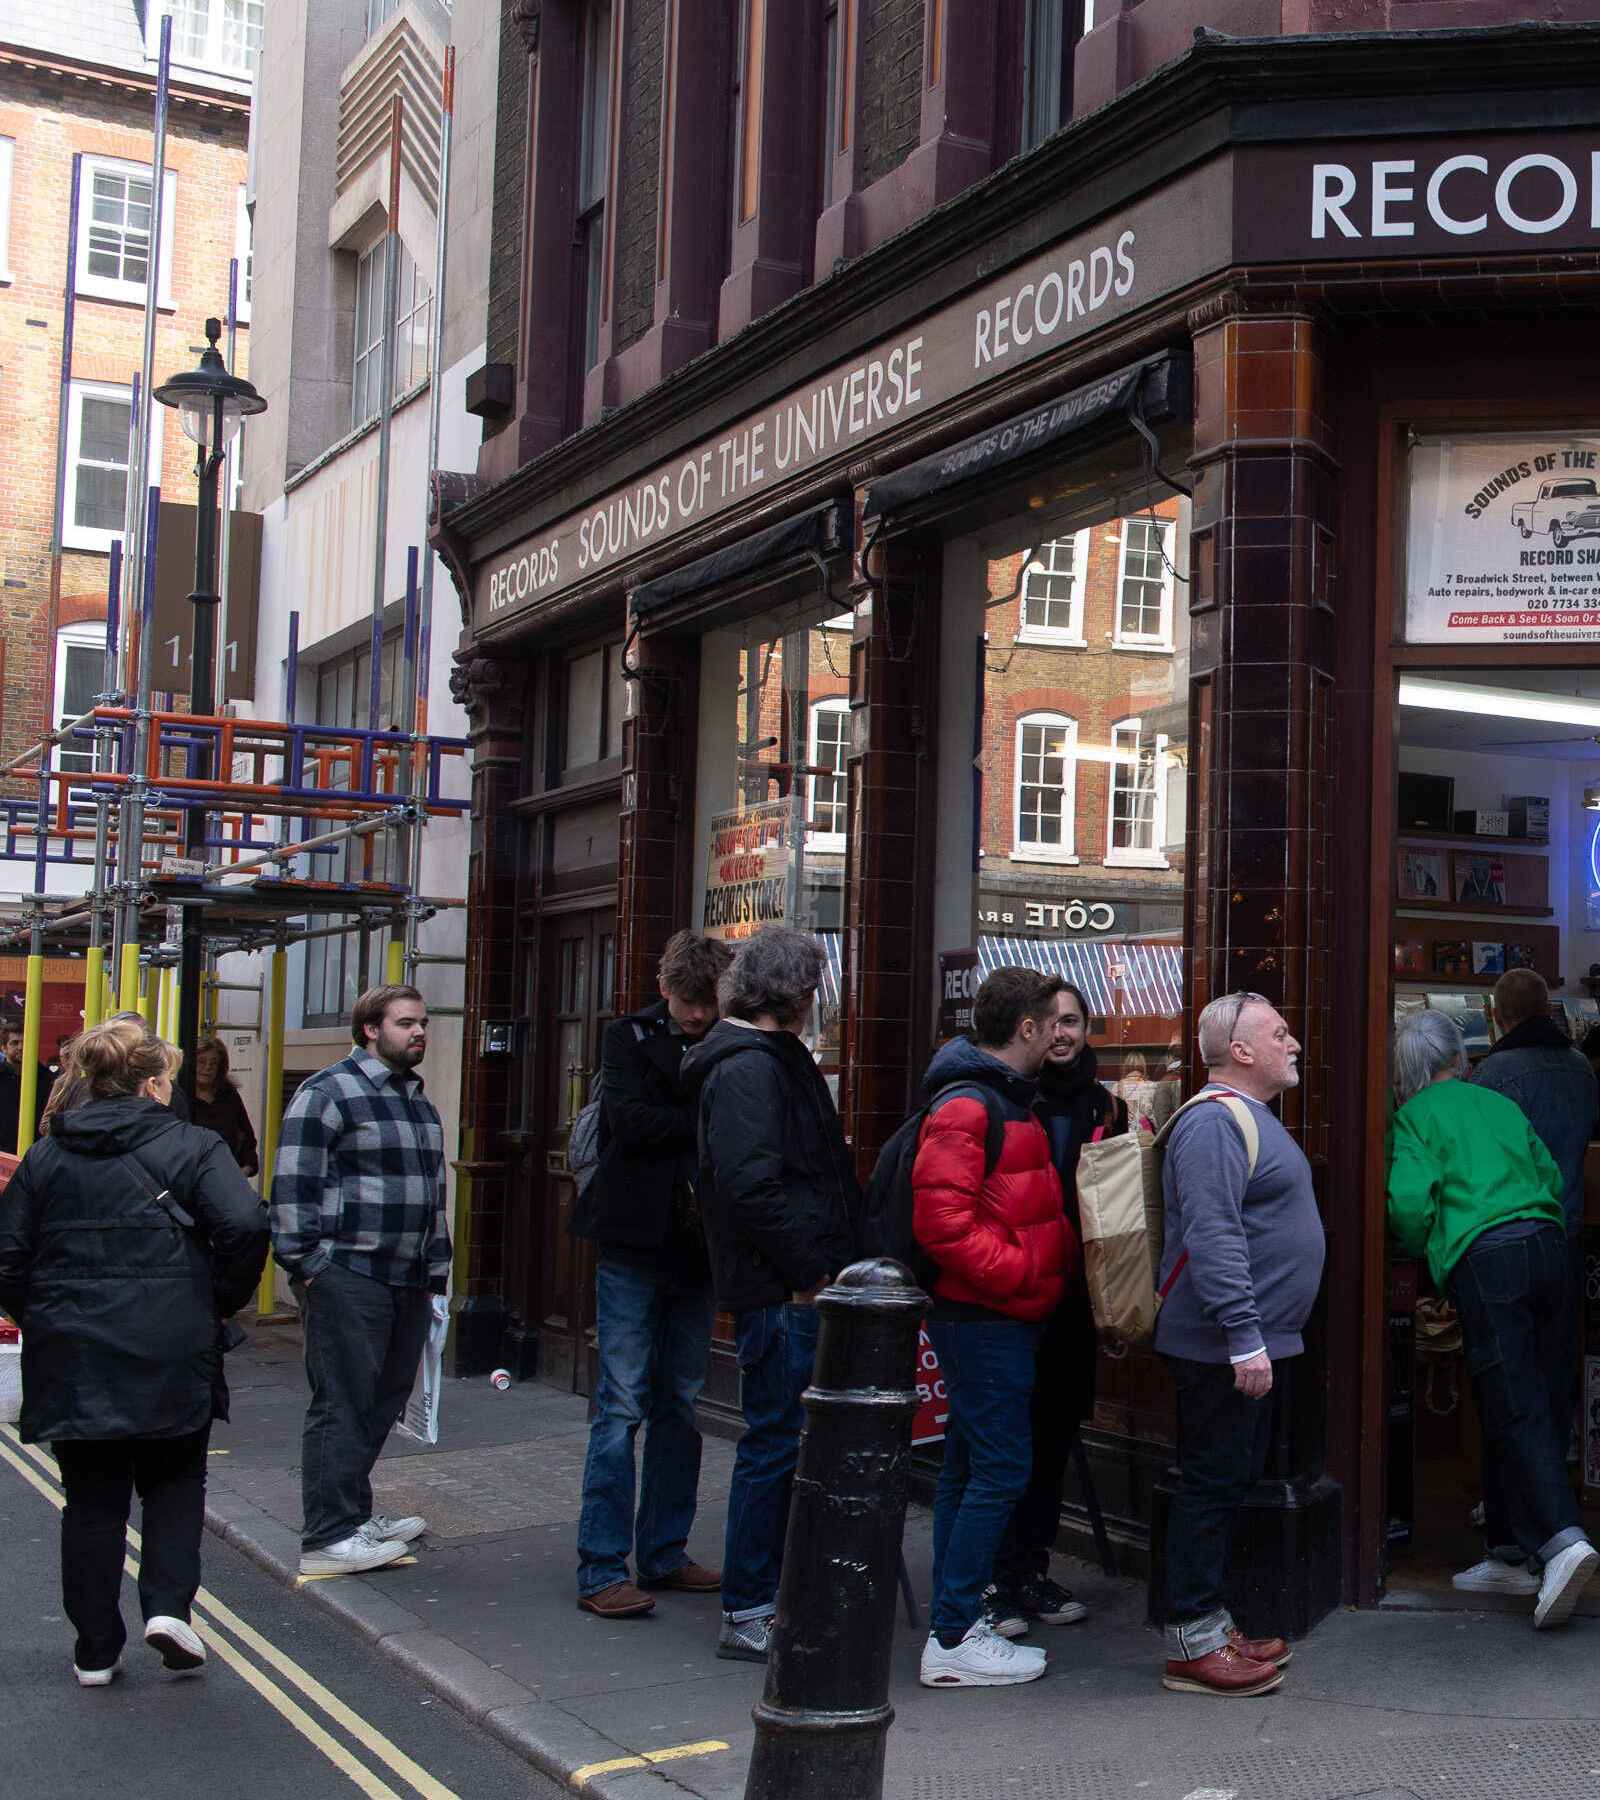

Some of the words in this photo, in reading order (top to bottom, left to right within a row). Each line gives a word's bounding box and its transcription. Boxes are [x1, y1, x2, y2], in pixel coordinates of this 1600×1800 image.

[975, 230, 1135, 368] RECORDS
[941, 432, 998, 475] SOUNDS
[999, 425, 1020, 451] OF
[1022, 411, 1049, 442] THE
[489, 539, 559, 612] RECORDS
[578, 474, 670, 570] SOUNDS
[677, 452, 711, 517] OF
[719, 422, 765, 498] THE
[774, 337, 924, 468] UNIVERSE
[1465, 461, 1532, 519] SOUNDS
[1534, 452, 1557, 473] OF
[1561, 451, 1596, 469] THE
[1520, 550, 1573, 567] RECORD
[1428, 587, 1451, 597] Auto
[1454, 587, 1494, 599] repairs,
[1496, 585, 1544, 598] bodywork
[1548, 585, 1556, 596] &
[1559, 585, 1588, 596] in-car
[1446, 574, 1453, 584] 7
[1456, 573, 1509, 585] Broadwick
[1512, 572, 1547, 585] Street,
[1551, 571, 1593, 583] between
[1452, 614, 1479, 625] Come
[1481, 614, 1506, 625] Back
[1508, 614, 1517, 624] &
[1519, 613, 1538, 624] See
[1540, 613, 1552, 624] Us
[1554, 613, 1580, 624] Soon
[1582, 613, 1594, 623] Or
[1527, 600, 1549, 610] 020
[1552, 599, 1580, 610] 7734
[165, 635, 238, 672] 11
[703, 884, 743, 927] RECORD
